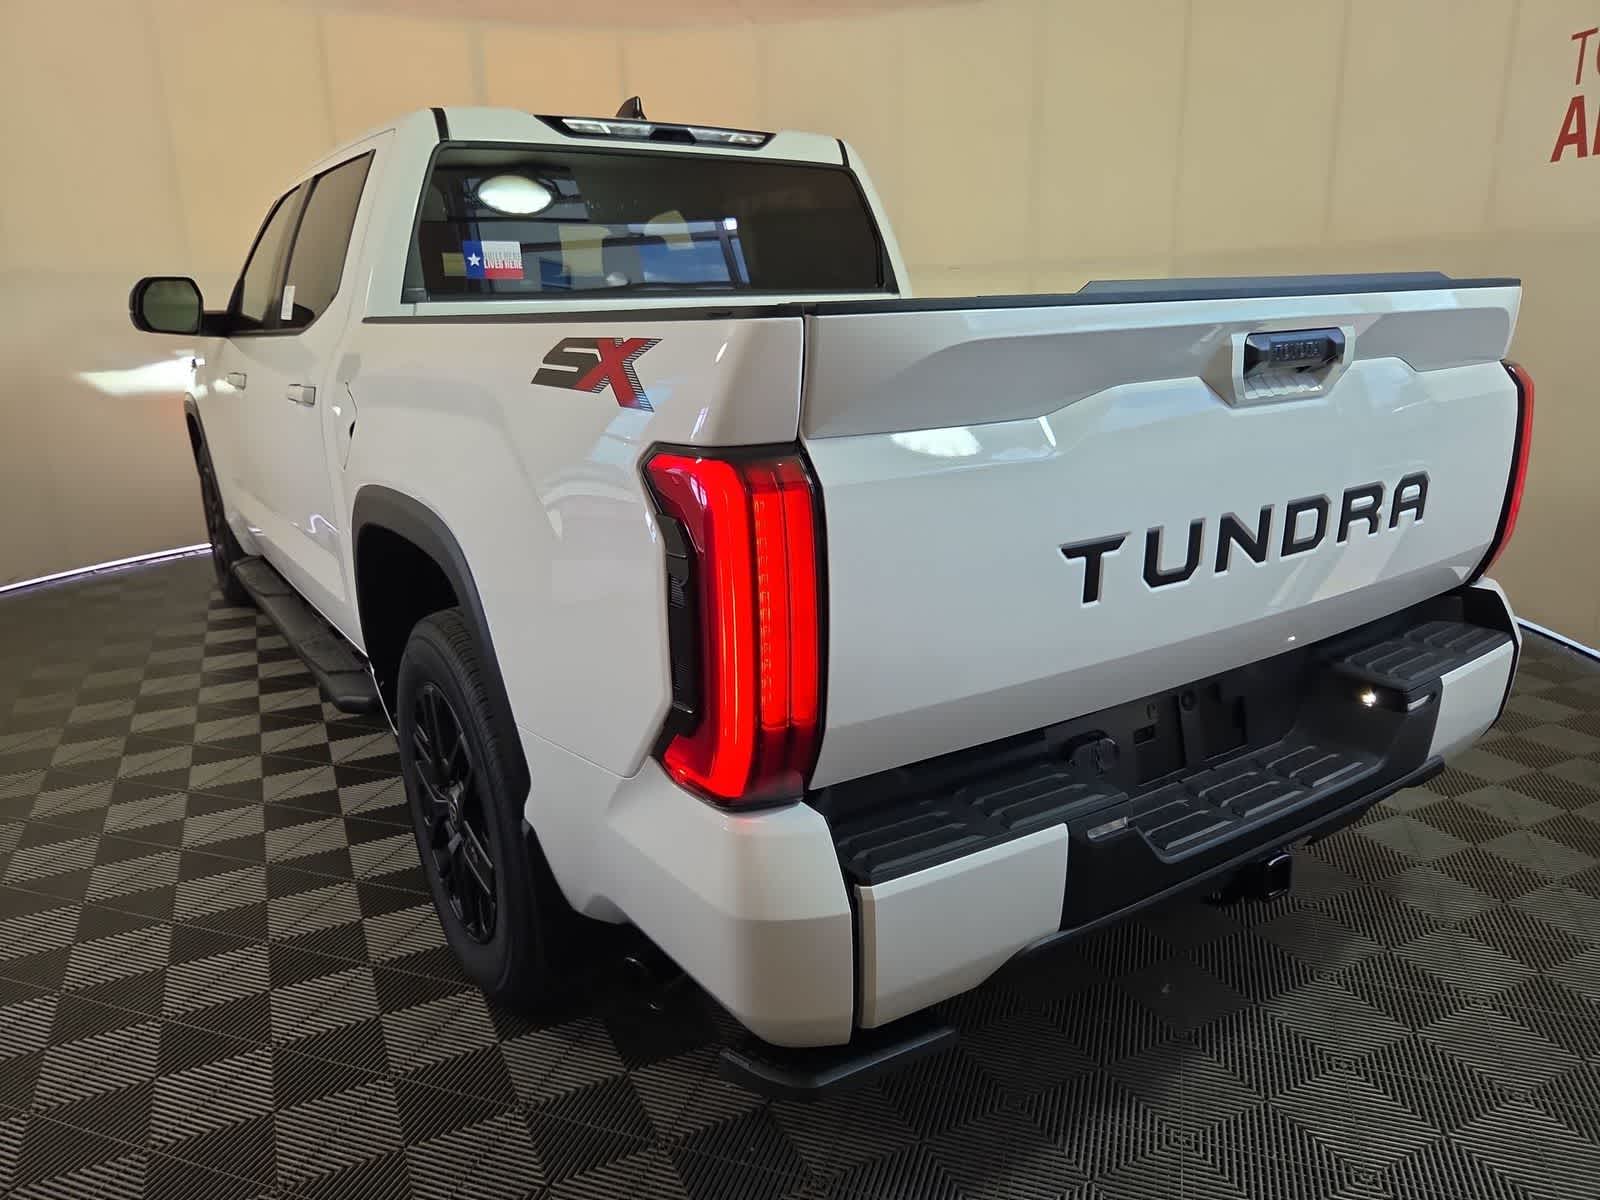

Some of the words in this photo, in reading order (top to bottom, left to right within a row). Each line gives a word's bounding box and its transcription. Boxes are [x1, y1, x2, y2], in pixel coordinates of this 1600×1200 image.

[1571, 27, 1600, 86] T
[1550, 95, 1600, 163] A
[1059, 470, 1430, 605] TUNDRA
